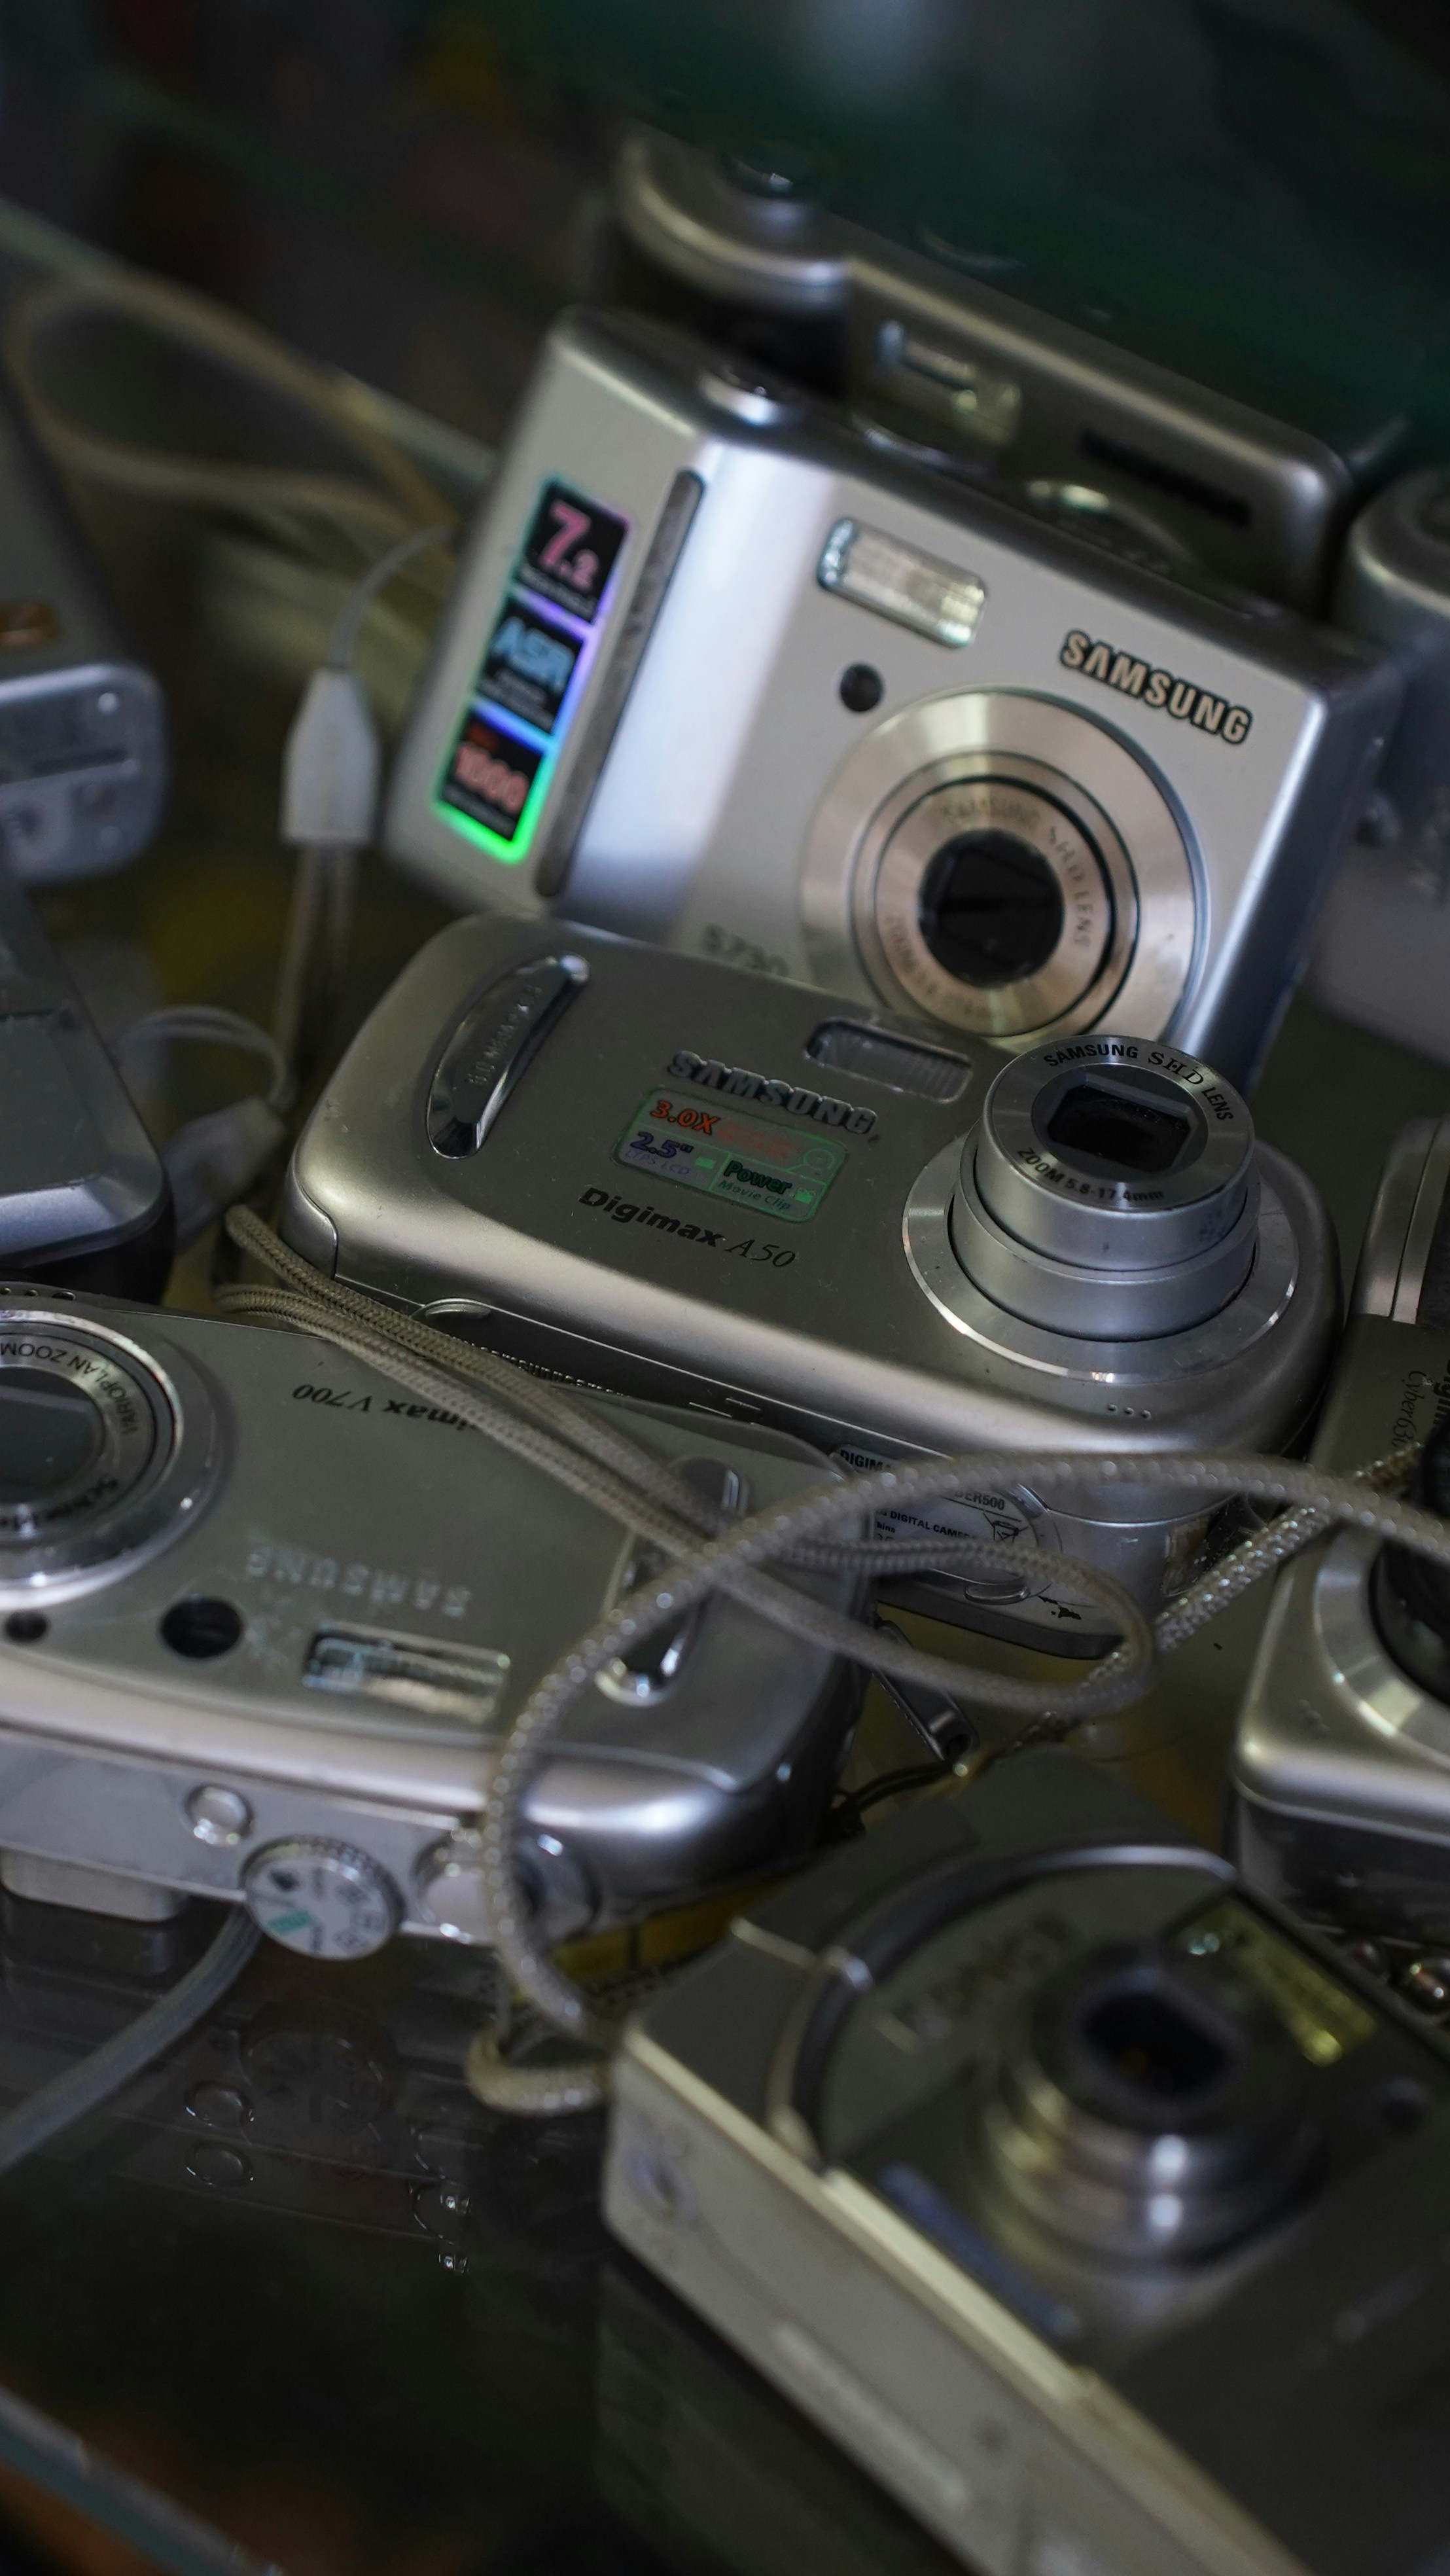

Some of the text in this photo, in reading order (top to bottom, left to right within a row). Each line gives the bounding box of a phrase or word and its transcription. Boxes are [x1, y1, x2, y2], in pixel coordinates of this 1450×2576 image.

[538, 499, 599, 590] 7.2
[1059, 630, 1253, 745] SAMSUNG
[1072, 890, 1094, 947] LENS
[667, 1050, 878, 1128] SAMSUNG
[1043, 1043, 1139, 1067] SAMSUNG
[1201, 1086, 1234, 1120] LENS
[650, 1100, 721, 1136] 3.0X
[629, 1131, 695, 1158] 2.5"
[1017, 1147, 1066, 1183] ZOOM
[663, 1158, 691, 1176] LCD
[723, 1160, 792, 1195] Power
[719, 1180, 792, 1211] Movie Clip
[578, 1187, 796, 1268] Digimax A50
[0, 1342, 137, 1436] VARIOPLAN ZOOM
[291, 1383, 478, 1433] imax V700
[840, 1450, 892, 1471] DIGIM
[876, 1520, 896, 1534] hina
[890, 1511, 930, 1530] DIGITAL
[245, 1545, 474, 1619] SAMSUNG
